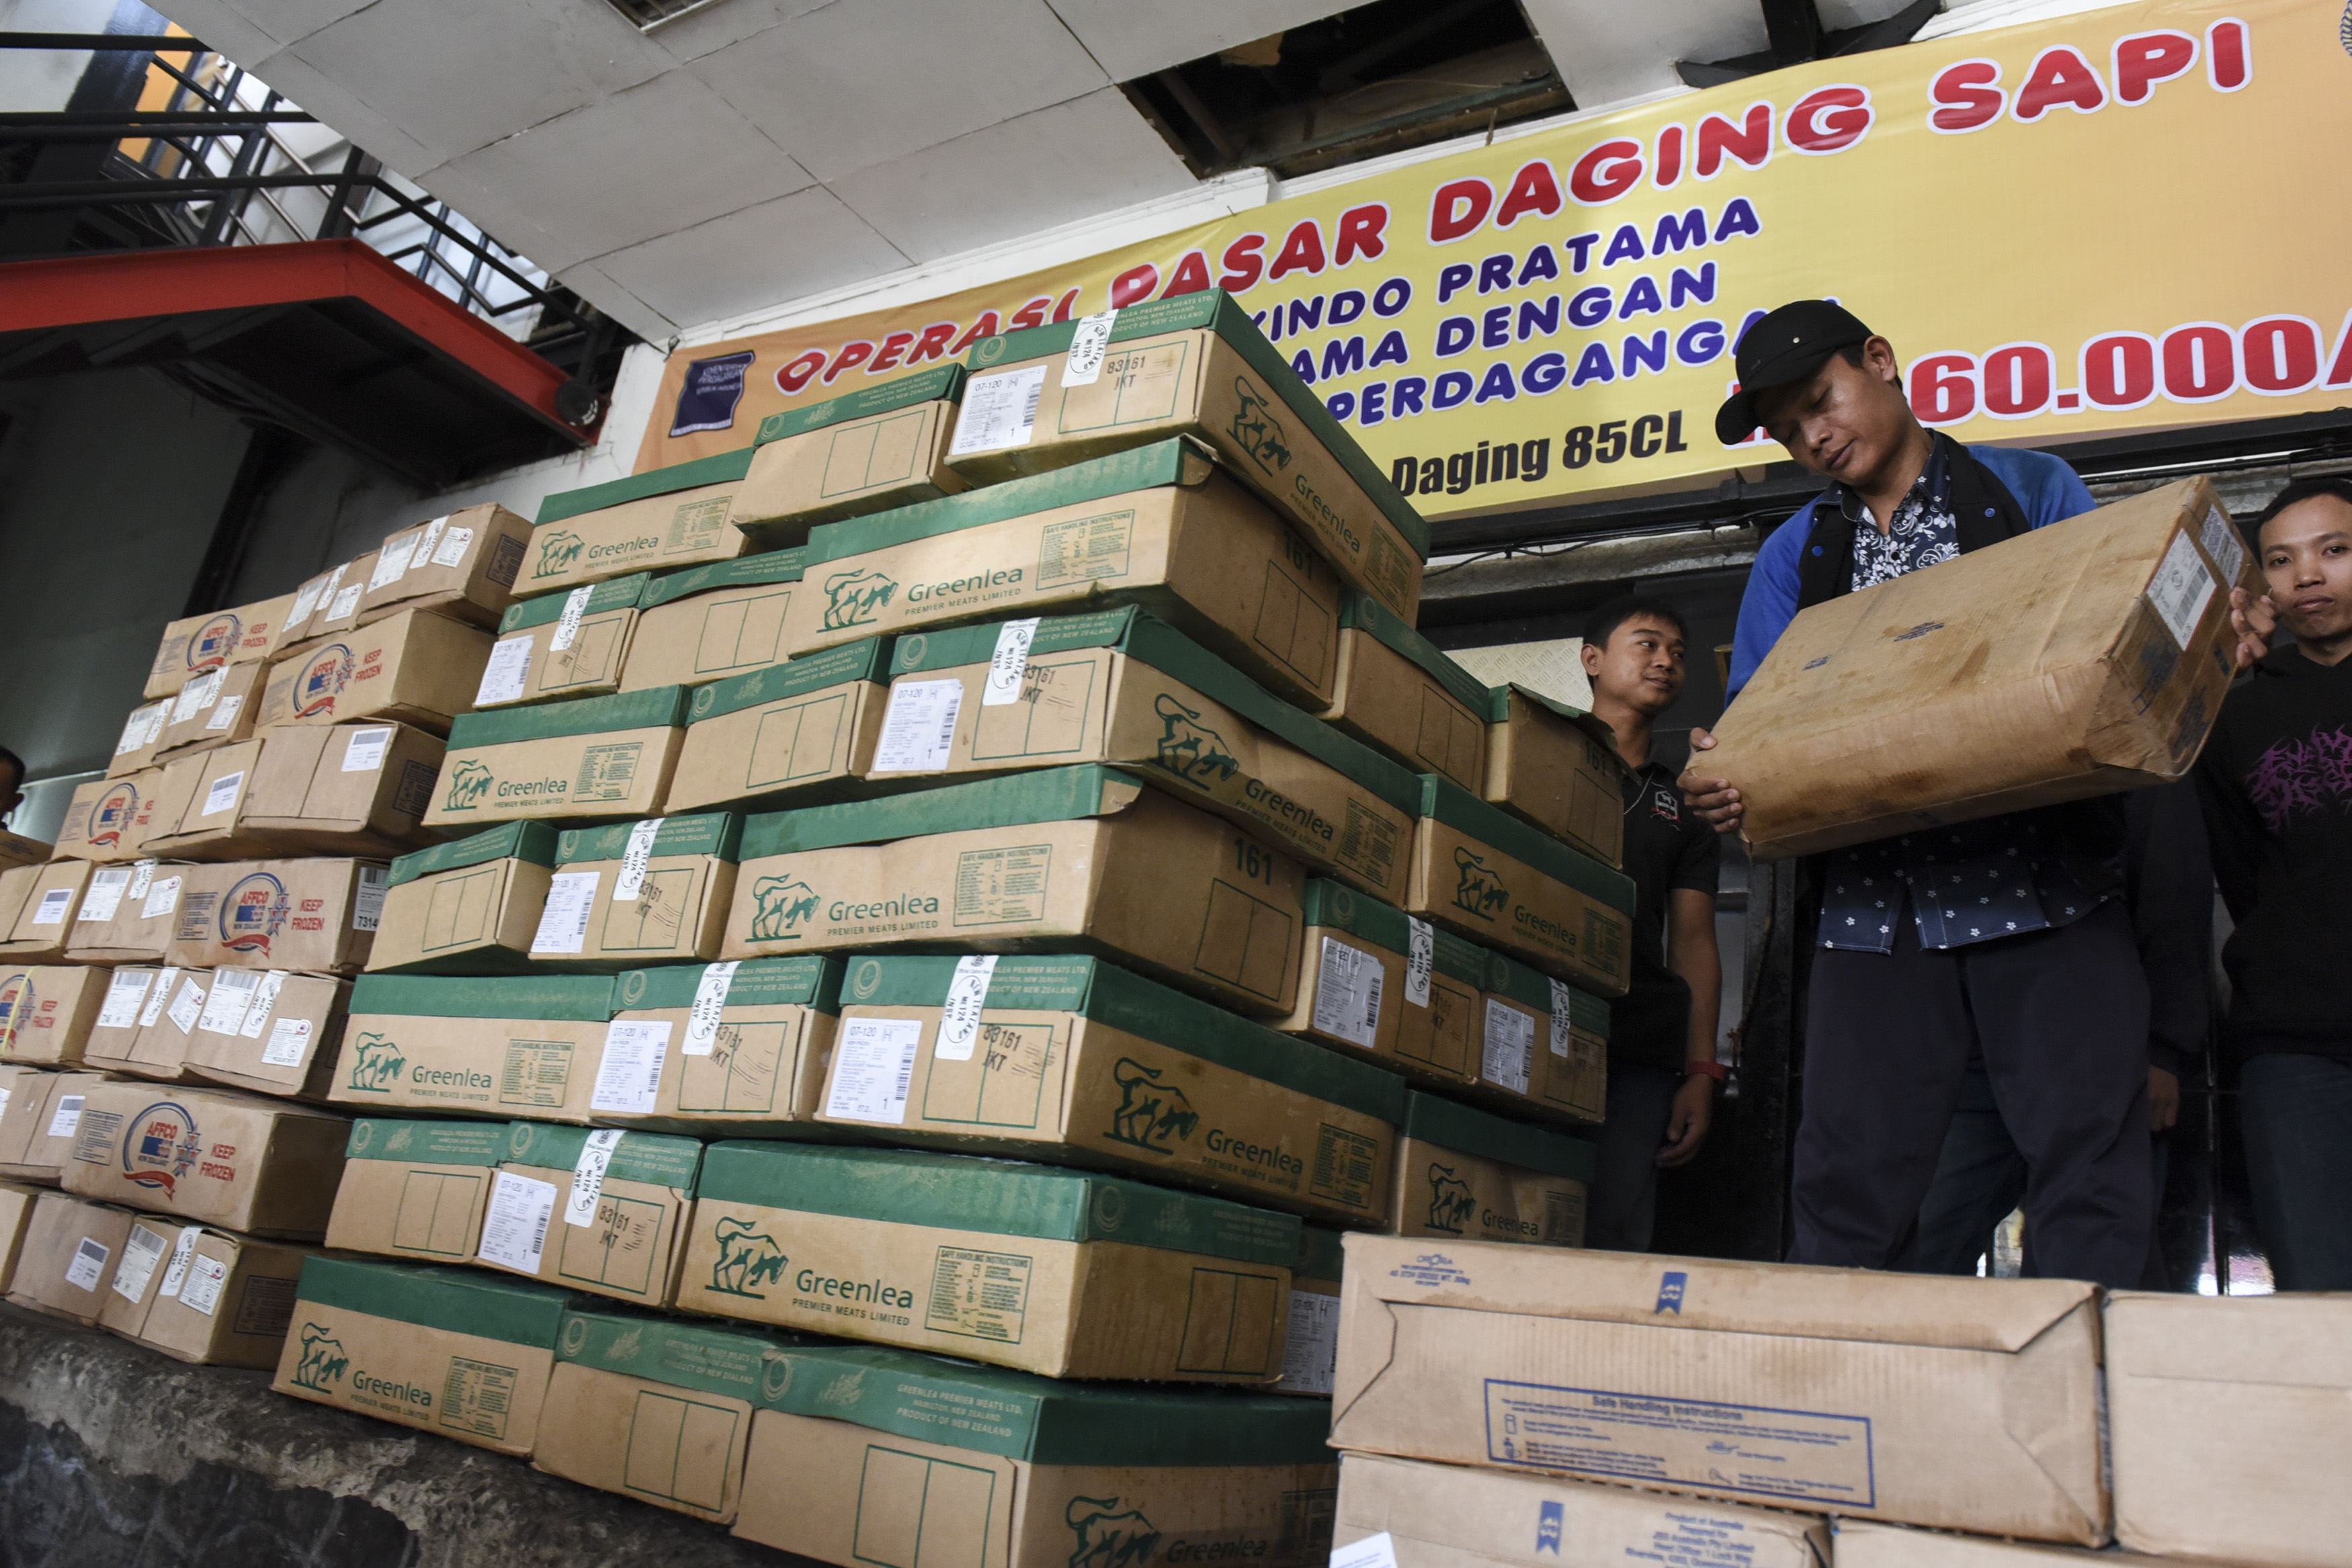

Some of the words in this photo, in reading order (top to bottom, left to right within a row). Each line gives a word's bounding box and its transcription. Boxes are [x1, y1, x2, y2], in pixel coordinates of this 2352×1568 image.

[775, 287, 1081, 395] OPERASI
[1110, 202, 1389, 310] PASAR
[1428, 85, 1874, 245] DAGING
[1927, 18, 2251, 133] SAPI
[1437, 197, 1760, 304] PRATAMA
[1141, 304, 1171, 314] PREMIER
[1172, 298, 1196, 309] MEATS
[1150, 312, 1165, 320] NEW
[1166, 305, 1195, 316] ZEALAND
[1110, 324, 1138, 335] RODUCT
[1139, 321, 1150, 330] OF
[1151, 317, 1168, 326] NEW
[1169, 311, 1204, 323] ZEALAND
[1292, 331, 1409, 384] AMA
[1433, 261, 1718, 357] DENGAN
[1107, 355, 1146, 374] 83161
[1327, 296, 1840, 428] PERDAGANGA
[974, 379, 1003, 392] 07-120
[1113, 374, 1137, 391] JKT
[1393, 430, 1550, 496] Daging
[1562, 410, 1688, 470] 85CL
[1046, 525, 1060, 535] SAFE
[1090, 511, 1132, 526] INSTRUCTIONS
[1296, 474, 1361, 554] Greenlea
[588, 536, 659, 559] Greenlea
[908, 568, 1023, 603] Greenlea
[905, 602, 945, 616] PREMIER
[948, 596, 979, 607] MEATS
[982, 588, 1021, 602] LIMITED
[204, 625, 228, 638] AFFCO
[249, 623, 267, 634] KEEP
[242, 636, 268, 650] FROZEN
[311, 658, 336, 677] AFFCO
[364, 648, 382, 666] KEEP
[354, 663, 382, 684] FROZEN
[1020, 687, 1043, 705] JKT
[497, 777, 567, 797] Greenlea
[495, 800, 518, 808] PREMIER
[1245, 778, 1334, 841] Greenlea
[1235, 799, 1272, 824] PREMIER
[1273, 818, 1298, 838] MEATS
[1298, 832, 1327, 854] LIMITED
[1234, 838, 1272, 886] 161
[241, 891, 269, 904] AFFCO
[300, 899, 323, 912] KEEP
[829, 893, 939, 921] Greenlea
[291, 917, 325, 930] FROZEN
[827, 926, 864, 937] PREMIER
[868, 923, 897, 933] MEATS
[900, 920, 938, 931] LIMITED
[1515, 905, 1577, 946] Greenlea
[1042, 986, 1078, 994] ZEALAND
[849, 1026, 878, 1037] 07-120
[982, 1023, 1022, 1051] 83161
[412, 1065, 492, 1088] Greenlea
[410, 1088, 437, 1097] PREMIER
[145, 1121, 178, 1139] AFFCO
[211, 1143, 236, 1160] KEEP
[1206, 1129, 1304, 1175] Greenlea
[200, 1161, 236, 1182] FROZEN
[1202, 1156, 1238, 1173] PREMIER
[1482, 1208, 1539, 1237] Greenea
[796, 1269, 914, 1309] Greenlea
[792, 1298, 832, 1313] PREMIER
[835, 1305, 866, 1319] MEATS
[870, 1311, 910, 1325] LIMITED
[353, 1370, 432, 1407] Greenlea
[897, 1384, 938, 1399] GREENLEA
[939, 1392, 974, 1405] PREMIER
[976, 1398, 1004, 1411] MEATS
[350, 1394, 378, 1406] PREMIER
[1593, 1395, 1617, 1408] Safe
[1620, 1399, 1671, 1415] Handling
[1673, 1404, 1743, 1421] Instructions
[896, 1407, 937, 1423] PRODUCT
[938, 1415, 950, 1425] OF
[951, 1419, 970, 1429] NEW
[971, 1422, 1013, 1438] ZEALAND
[952, 1407, 966, 1415] NEW
[968, 1409, 1001, 1422] ZEALAND
[1167, 1535, 1267, 1563] Greenlea
